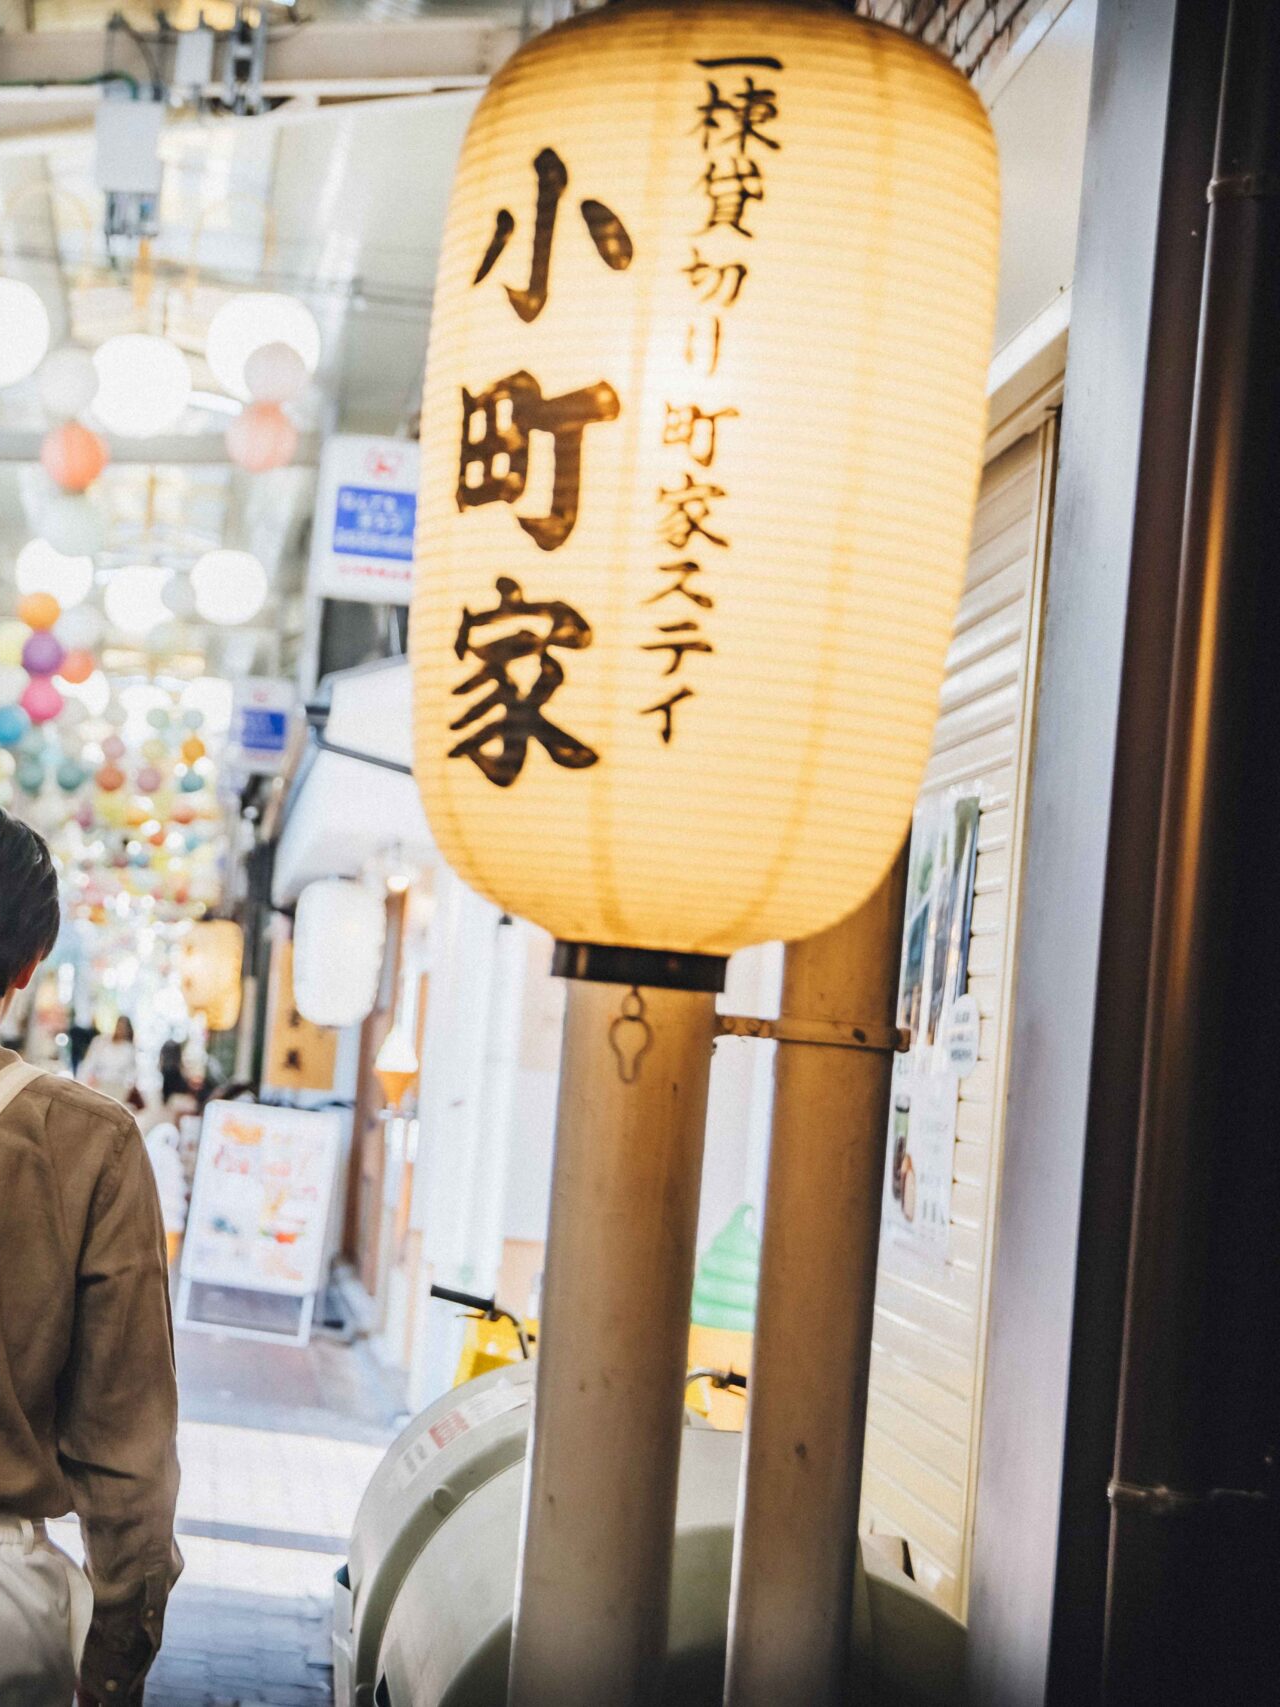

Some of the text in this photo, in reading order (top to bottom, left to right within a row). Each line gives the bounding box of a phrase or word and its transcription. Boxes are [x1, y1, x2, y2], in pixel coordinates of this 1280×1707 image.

[448, 147, 634, 788] 小町家
[640, 54, 784, 745] 一棟貸切り町家ステイ
